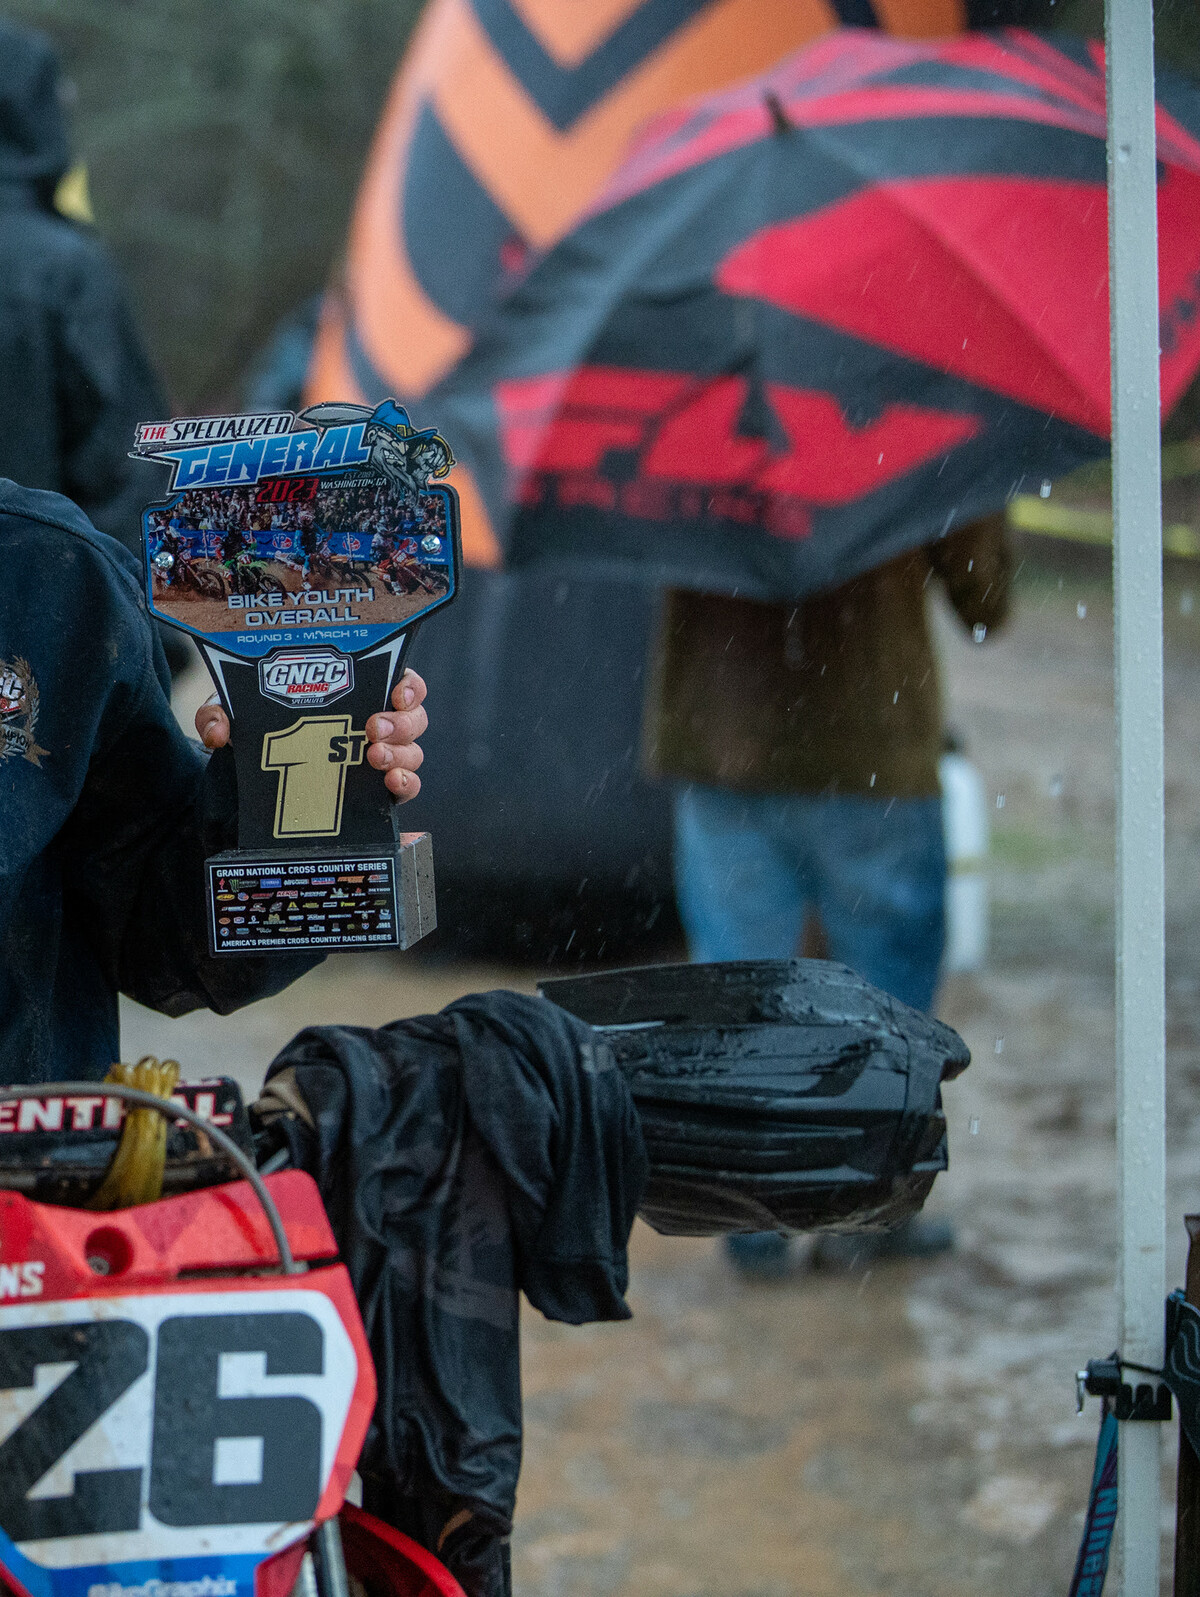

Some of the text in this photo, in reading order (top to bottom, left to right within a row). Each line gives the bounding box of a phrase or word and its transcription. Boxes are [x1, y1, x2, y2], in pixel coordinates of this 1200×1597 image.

[142, 416, 290, 440] THE SPECIALIZED
[153, 424, 372, 490] GENERAL
[256, 478, 320, 503] 2023
[227, 587, 374, 609] BIKE YOUTH
[245, 607, 360, 627] OVERALL
[237, 629, 368, 643] ROUND 3 MARCH 12
[268, 661, 346, 686] GNCC
[287, 683, 330, 694] RACING
[216, 862, 388, 878] GRAND NATIONAL CROSS COUNTRY SERIES
[221, 933, 392, 948] AMERICA'S PREMIER CROSS COUNTRY RACING SERIES
